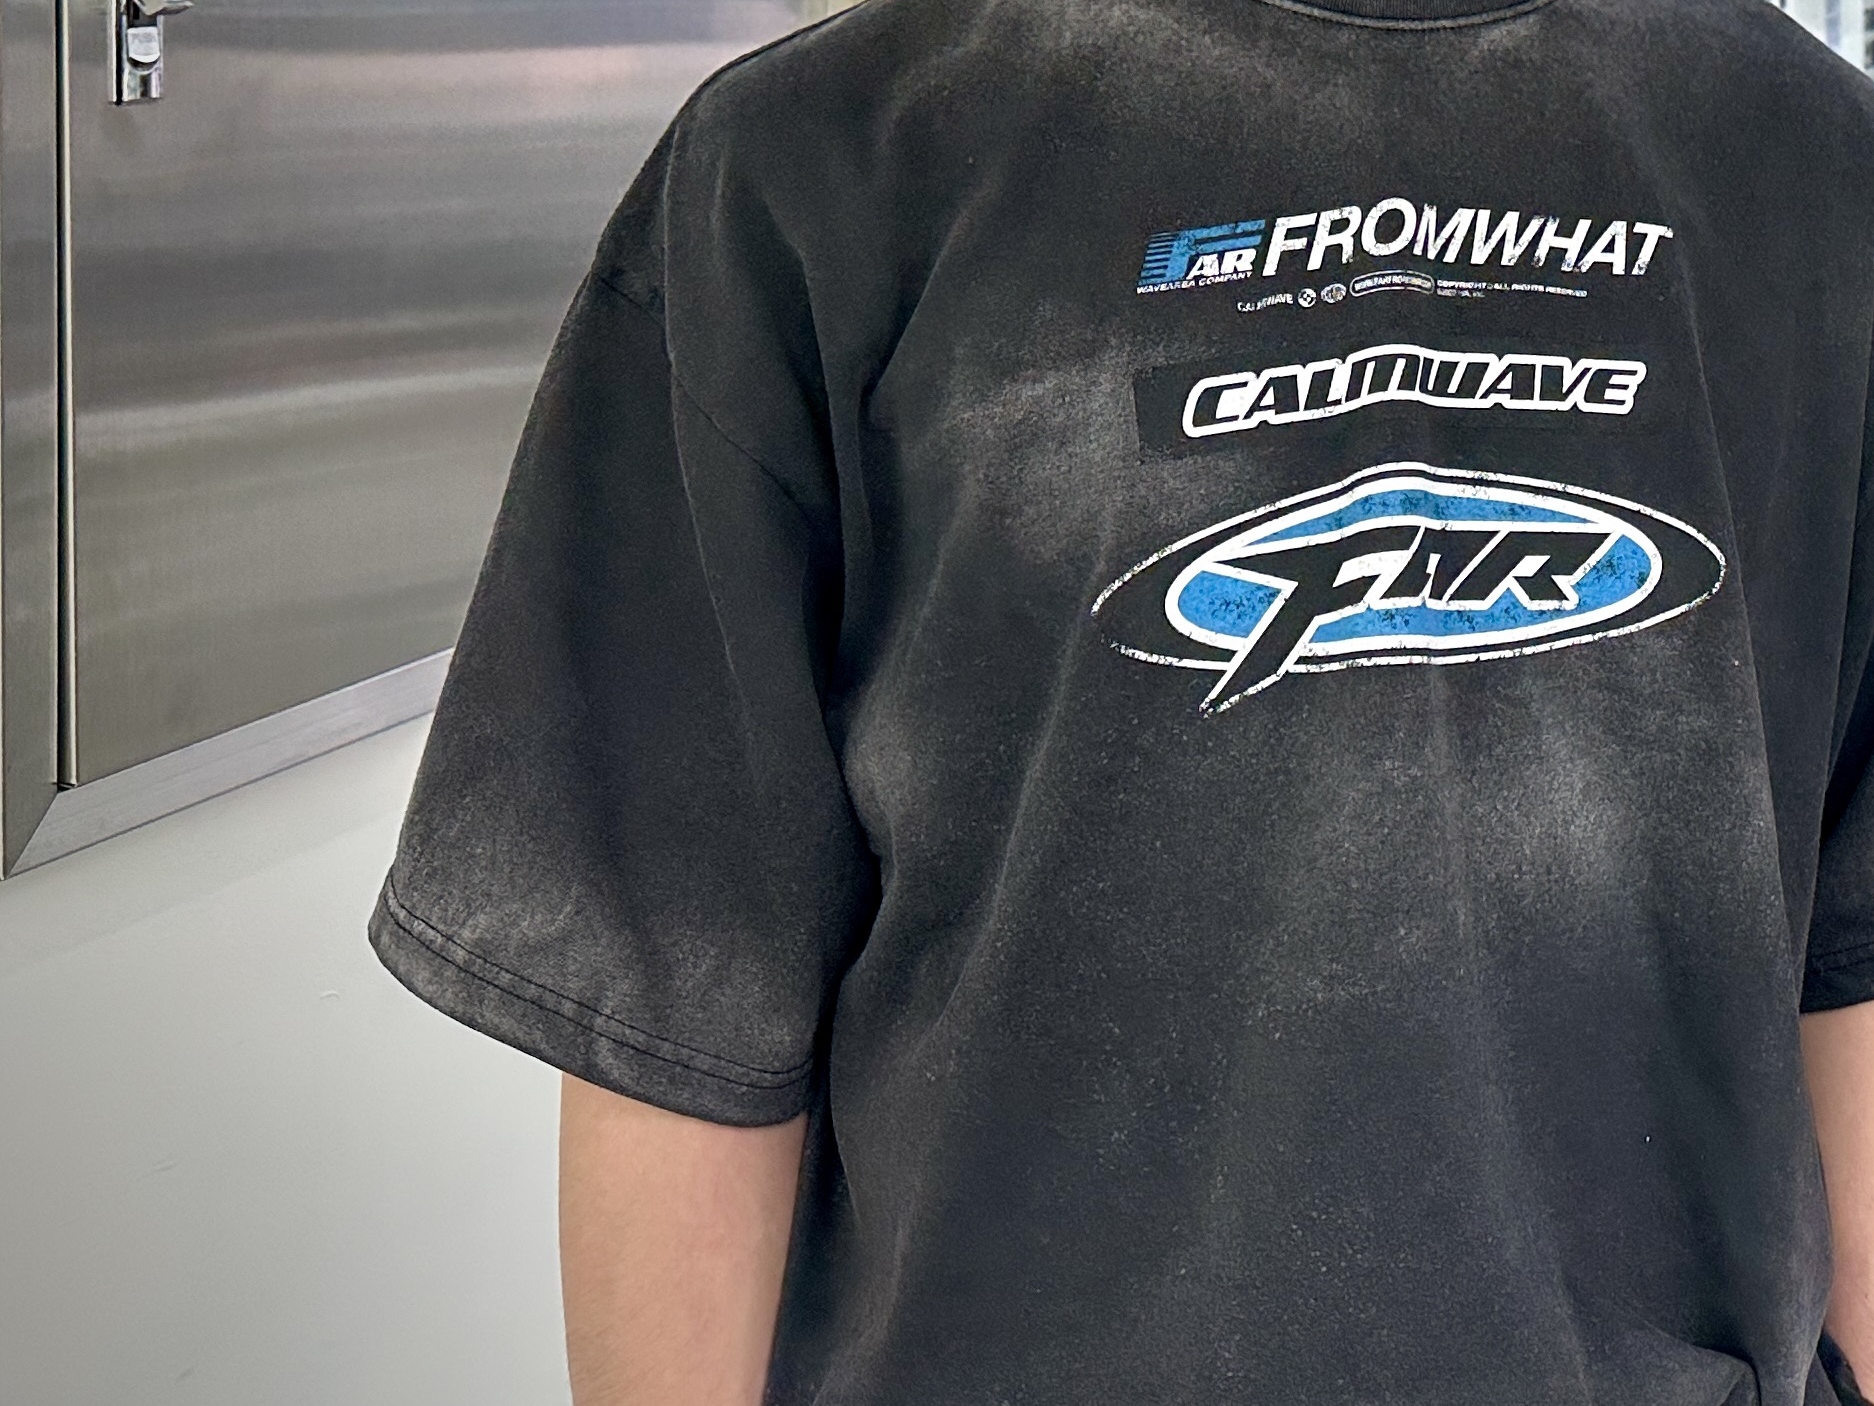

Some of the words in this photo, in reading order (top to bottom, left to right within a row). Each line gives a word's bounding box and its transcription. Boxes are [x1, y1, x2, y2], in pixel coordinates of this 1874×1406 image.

[1198, 271, 1253, 286] COMPANY
[1262, 197, 1673, 276] FROMWHAT
[1182, 343, 1647, 437] CALMWAVE
[1203, 524, 1625, 716] FAR
